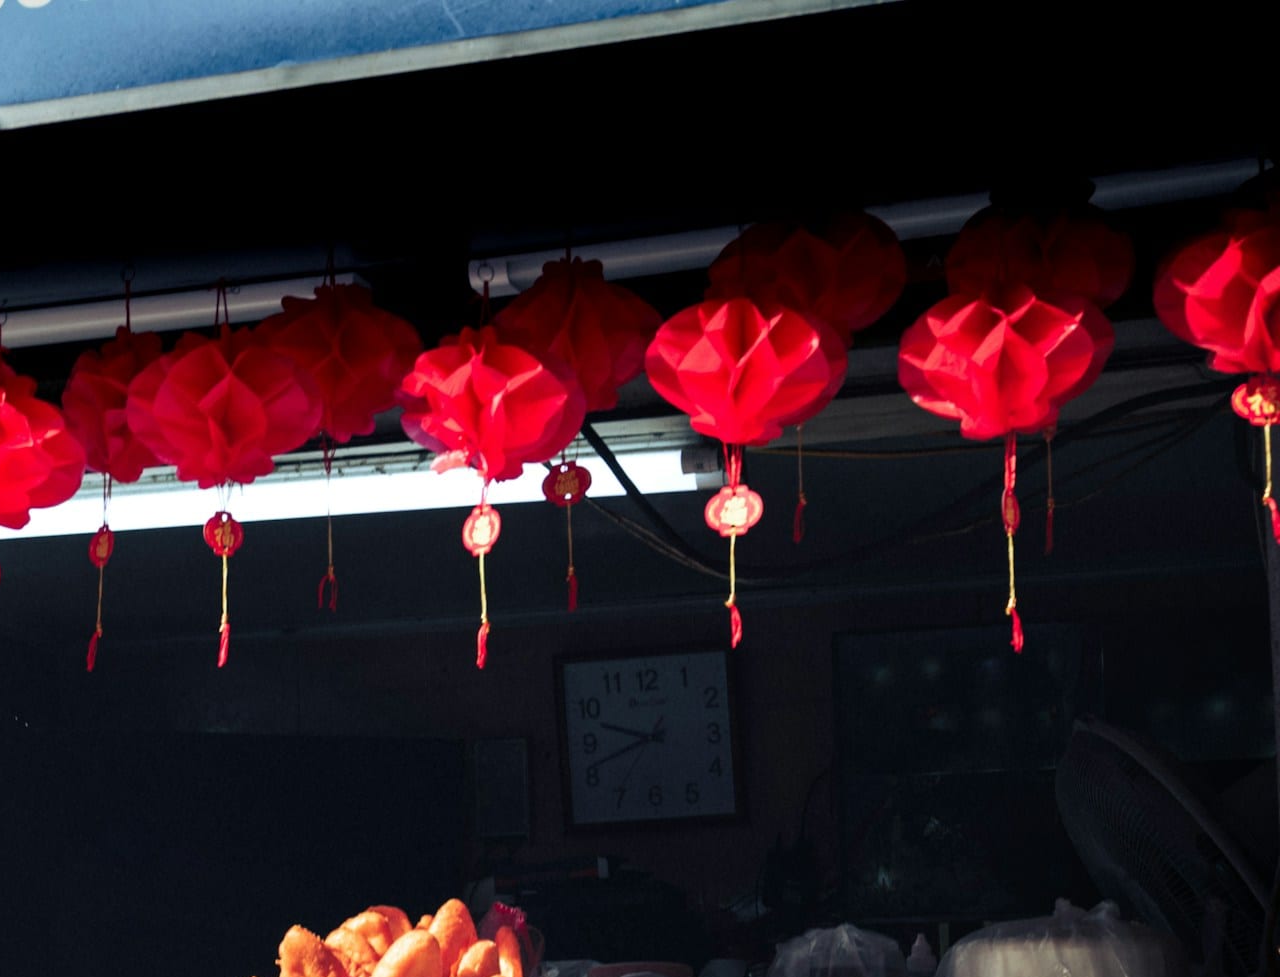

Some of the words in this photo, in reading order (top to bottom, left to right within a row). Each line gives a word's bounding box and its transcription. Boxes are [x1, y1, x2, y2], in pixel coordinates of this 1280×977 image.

[603, 672, 621, 694] 11
[637, 669, 659, 692] 12
[680, 666, 688, 688] 1
[579, 697, 600, 720] 10
[704, 688, 719, 708] 2
[583, 733, 597, 754] 9
[708, 723, 720, 744] 3
[586, 766, 600, 787] 8
[709, 757, 722, 776] 4
[613, 788, 626, 809] 7
[649, 785, 663, 806] 6
[686, 783, 699, 803] 5
